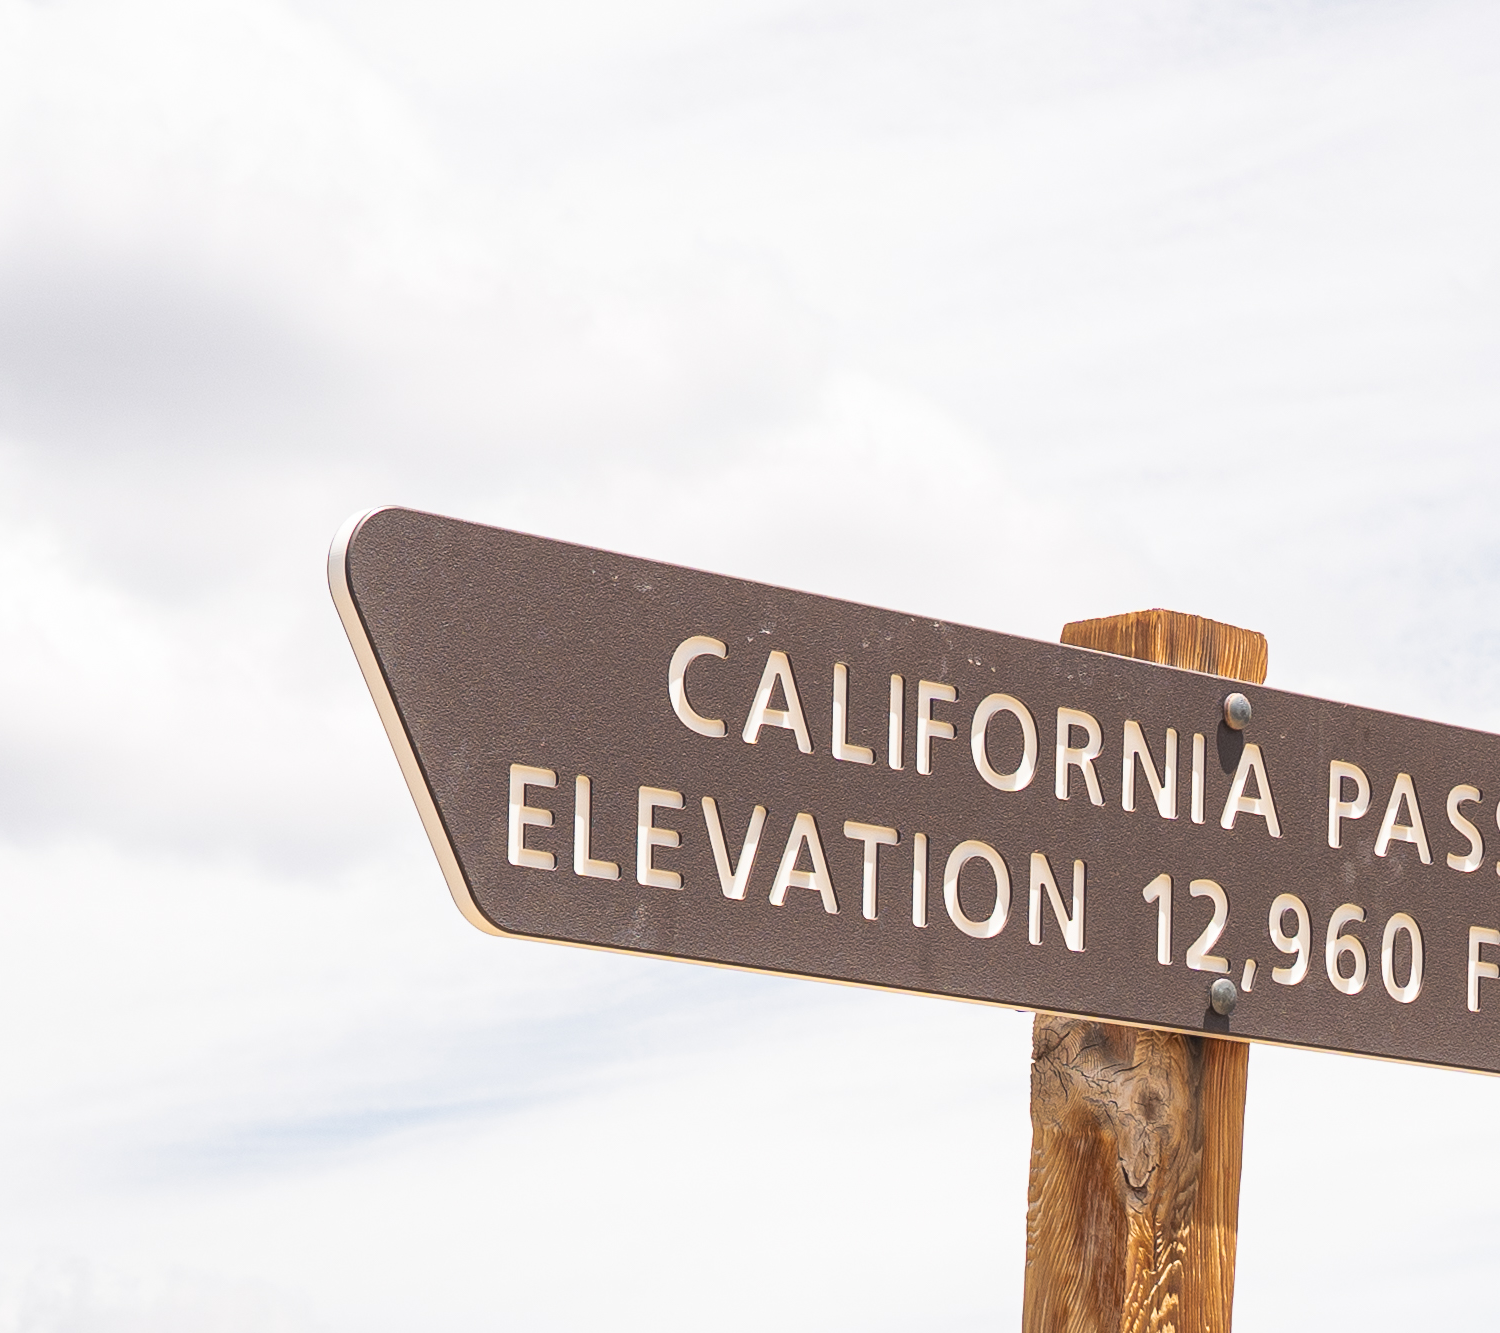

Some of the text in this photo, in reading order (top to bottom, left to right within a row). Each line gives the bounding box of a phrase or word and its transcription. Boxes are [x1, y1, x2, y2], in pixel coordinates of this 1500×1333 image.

[667, 634, 1283, 839] CALIFORNIA
[507, 763, 1087, 952] ELEVATION
[1141, 873, 1425, 1004] 12,960
